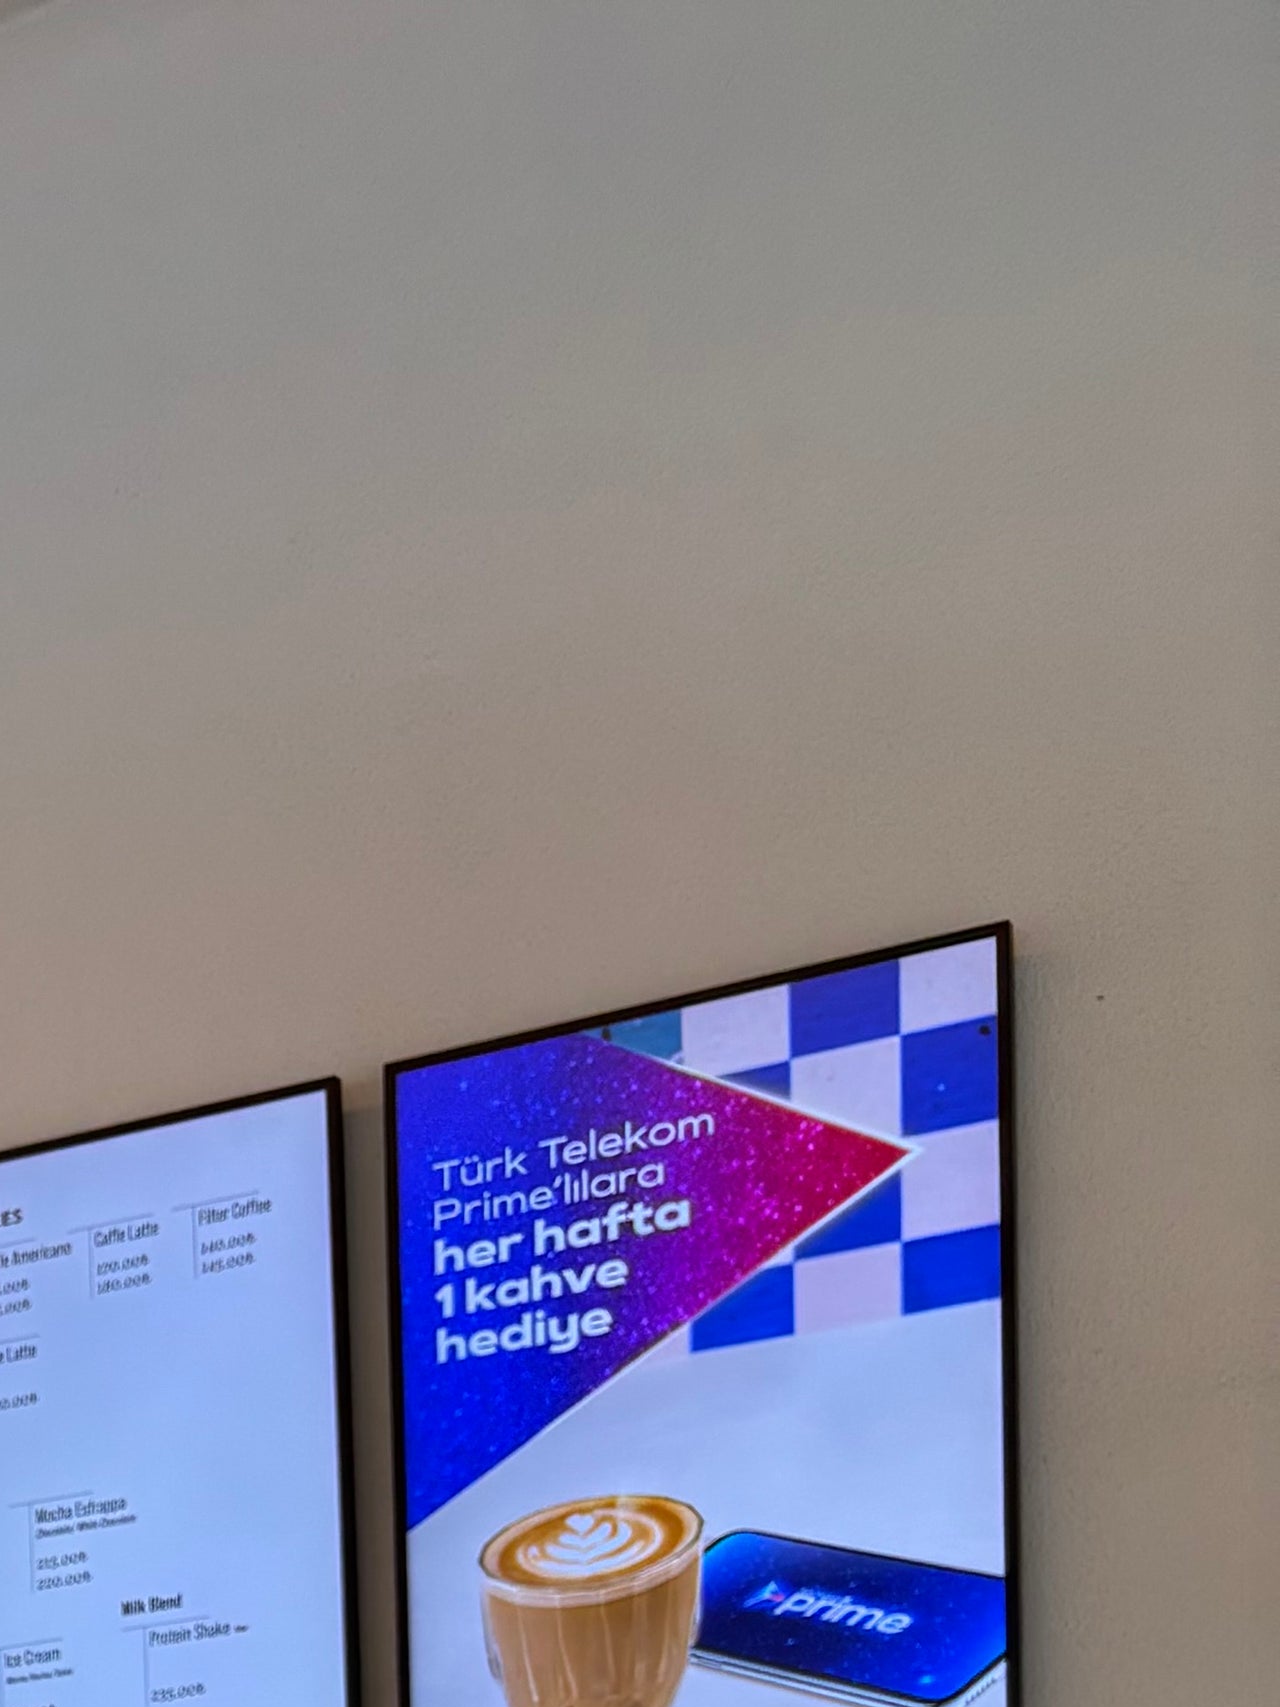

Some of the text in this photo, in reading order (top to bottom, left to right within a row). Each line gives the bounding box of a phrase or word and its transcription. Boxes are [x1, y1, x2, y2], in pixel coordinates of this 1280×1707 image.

[432, 1112, 715, 1191] Türk Telekom
[434, 1200, 690, 1276] her hafta
[435, 1259, 629, 1318] 1 kahve
[436, 1307, 613, 1364] hediye
[773, 1588, 914, 1635] prime
